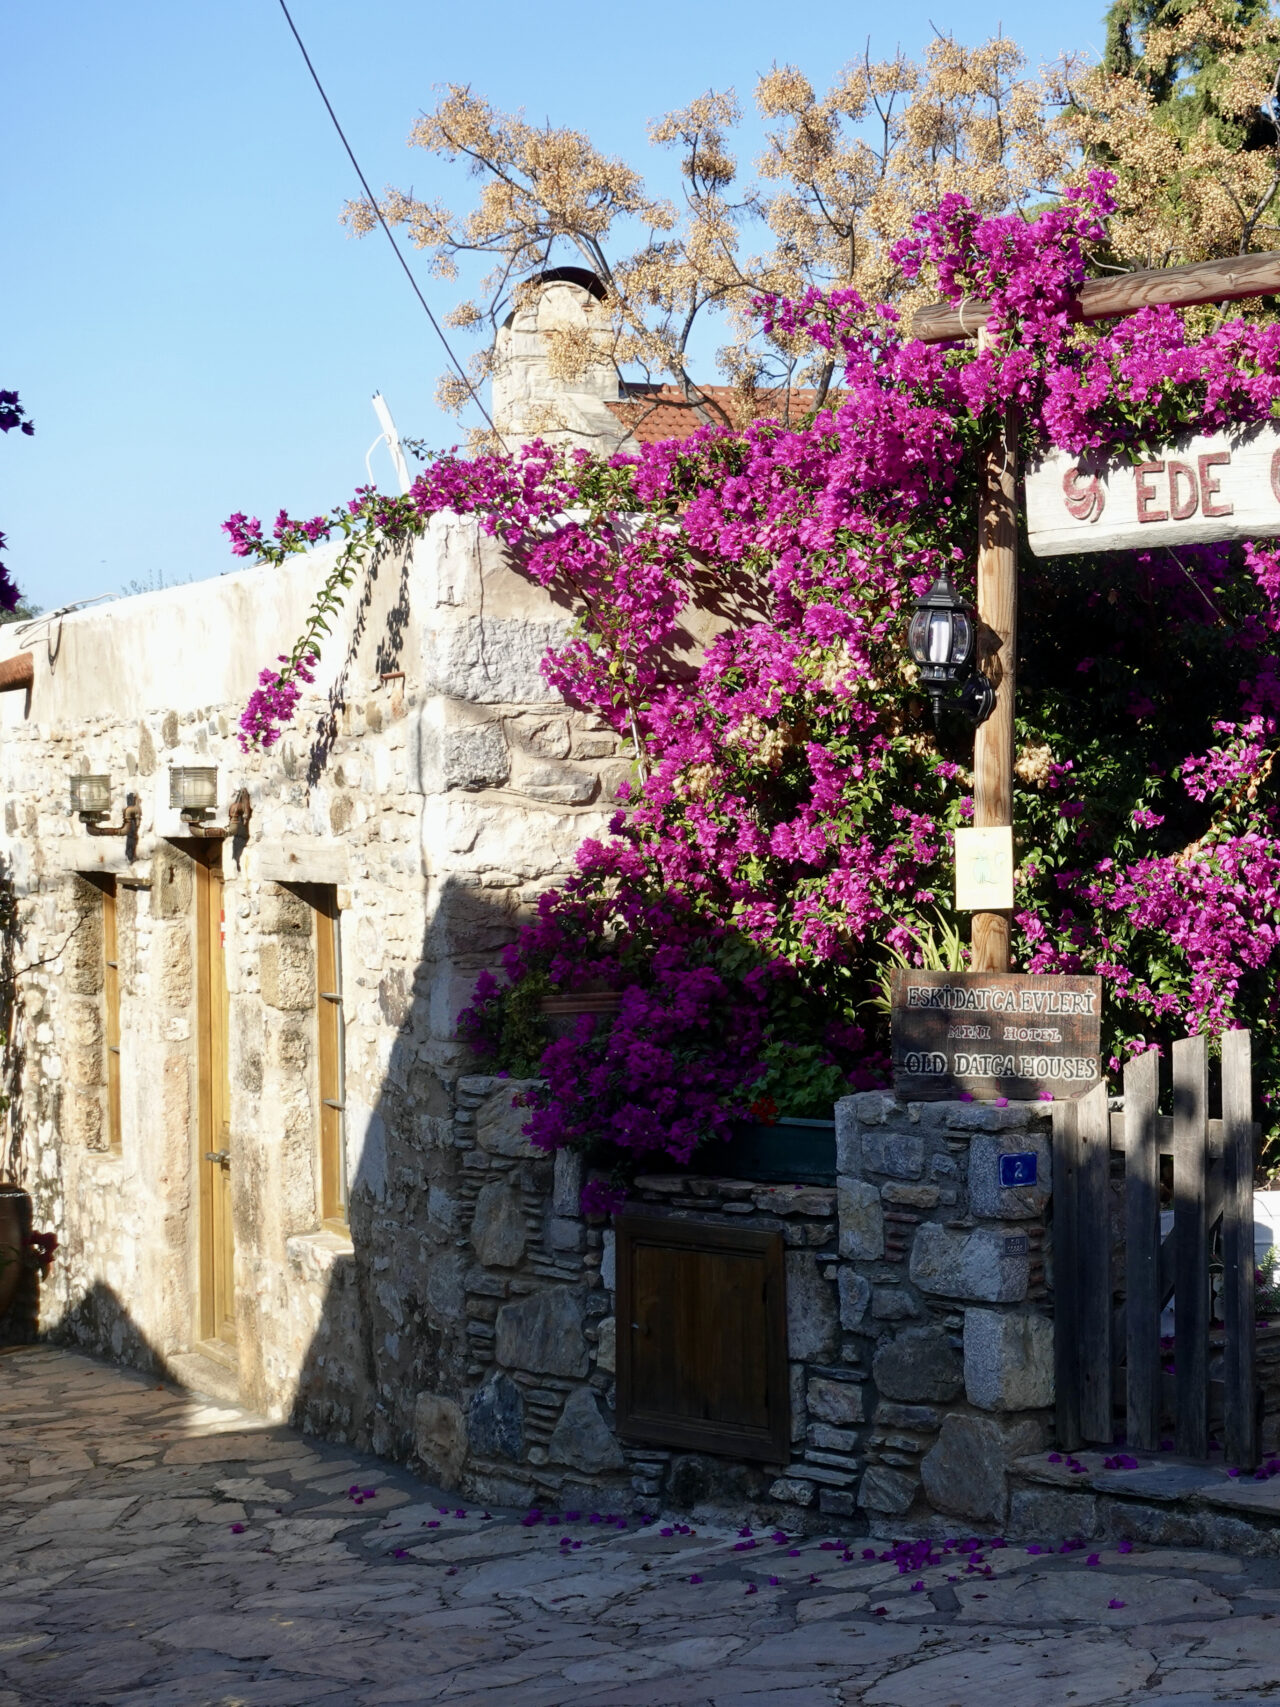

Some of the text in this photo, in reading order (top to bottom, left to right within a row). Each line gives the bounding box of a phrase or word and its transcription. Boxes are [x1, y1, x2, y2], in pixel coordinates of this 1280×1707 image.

[1134, 451, 1234, 523] EDE
[1019, 989, 1096, 1016] EVLERİ
[948, 1024, 1062, 1043] MINI HOTEL
[905, 1051, 948, 1076] OLD
[1018, 1055, 1097, 1082] HOUSES
[1014, 1161, 1024, 1179] 2
